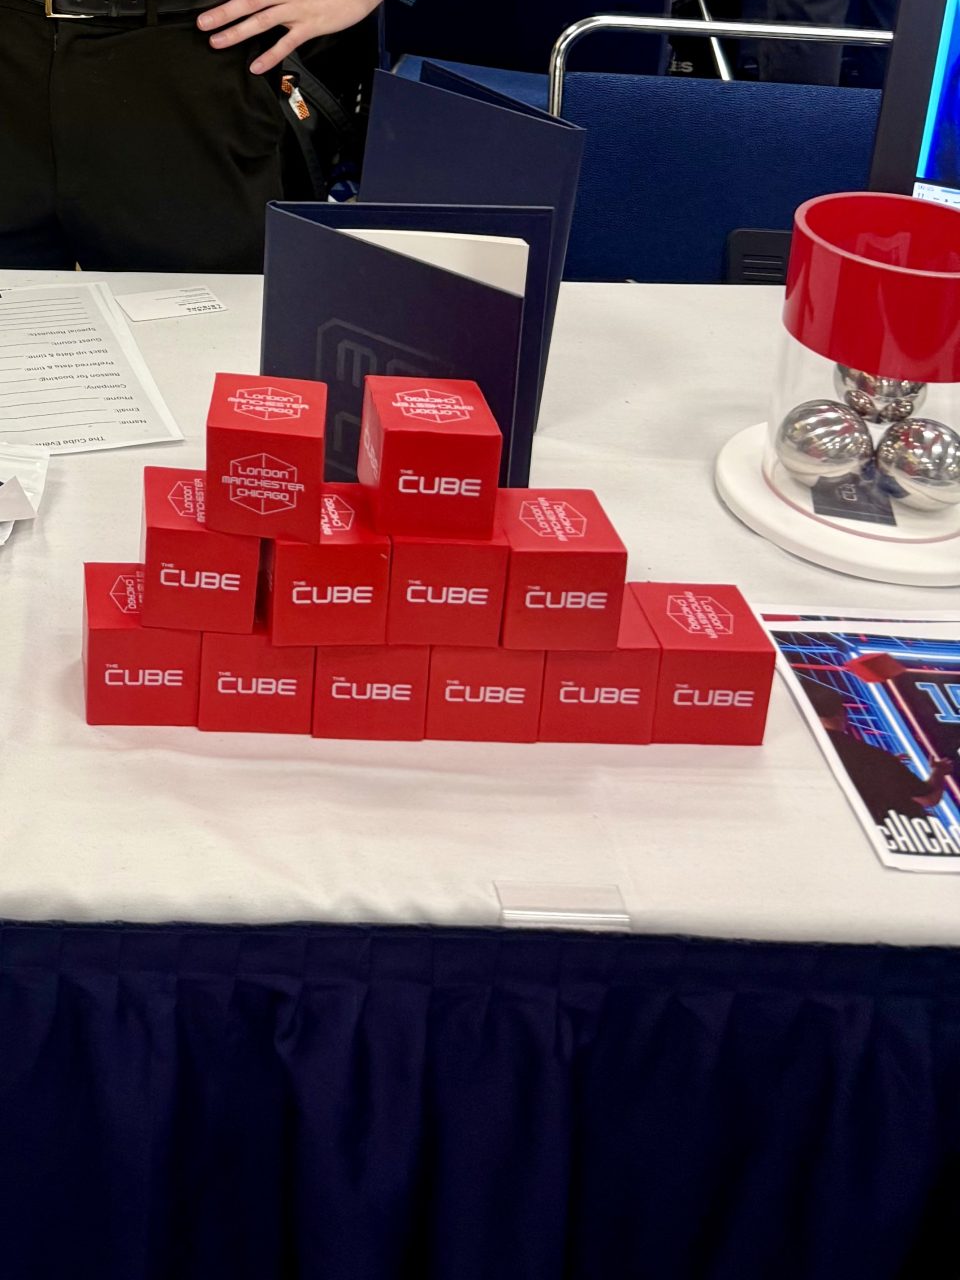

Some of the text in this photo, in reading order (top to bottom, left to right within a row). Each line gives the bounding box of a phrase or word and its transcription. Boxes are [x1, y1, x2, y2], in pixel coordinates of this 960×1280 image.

[227, 397, 310, 410] MANCHESTER
[244, 392, 294, 402] LONDON
[238, 466, 289, 479] LONDON
[221, 475, 305, 492] MANCHESTER
[398, 475, 482, 497] CUBE
[236, 488, 290, 501] CHICAGO
[160, 568, 241, 591] CUBE
[125, 579, 136, 609] CHICAGO
[292, 586, 373, 604] CUBE
[406, 585, 489, 605] CUBE
[525, 591, 608, 609] CUBE
[104, 669, 183, 686] CUBE
[217, 677, 298, 696] CUBE
[331, 682, 412, 701] CUBE
[445, 685, 526, 704] CUBE
[559, 686, 641, 705] CUBE
[673, 689, 755, 707] CUBE
